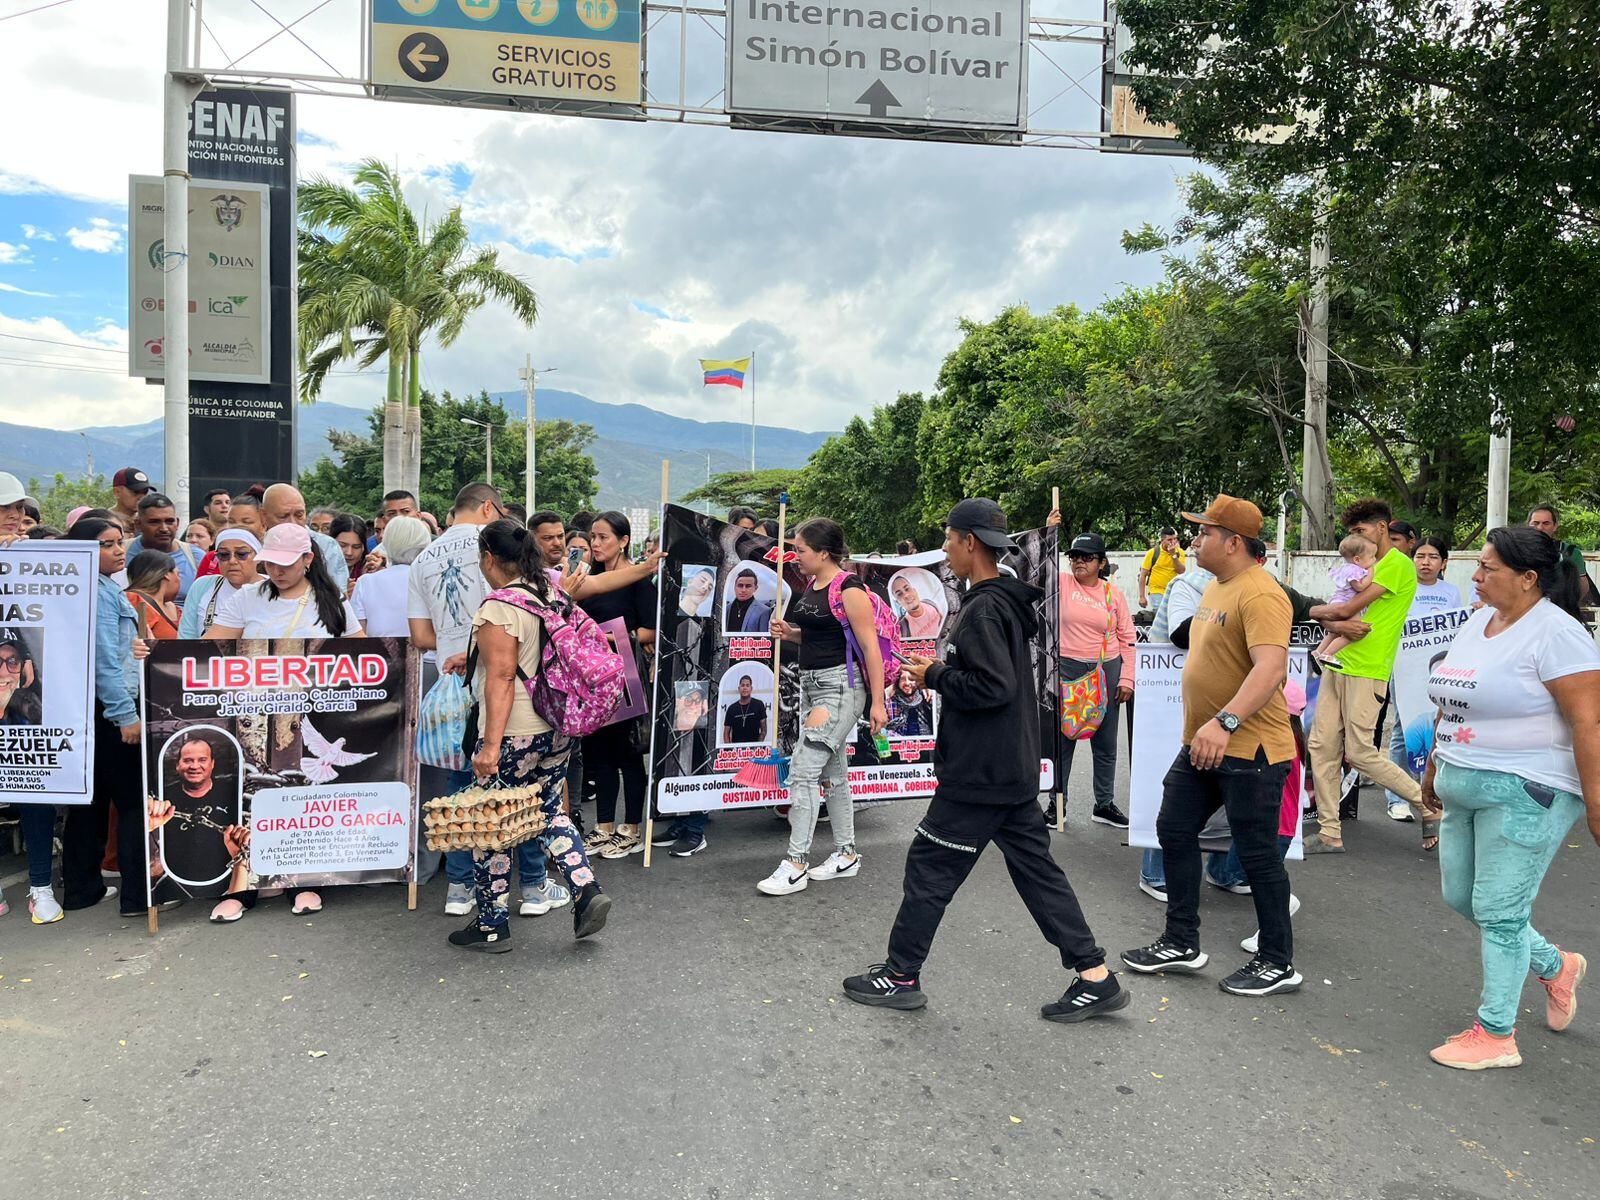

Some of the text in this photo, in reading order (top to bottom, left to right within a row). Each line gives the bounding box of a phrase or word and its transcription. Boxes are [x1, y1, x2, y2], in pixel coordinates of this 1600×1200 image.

[748, 0, 1002, 37] Internacional
[497, 44, 611, 69] SERVICIOS
[745, 36, 1009, 79] Simón Bolívar
[491, 67, 617, 92] GRATUITOS
[189, 139, 279, 155] NTRO NACIONAL DE
[187, 150, 285, 167] NCIÓN EN FRONTERAS
[219, 255, 254, 268] DIAN
[208, 297, 234, 314] ica
[188, 395, 284, 409] ÚBLICA DE COLOMBIA
[188, 407, 276, 419] ORTE DE SANTANDER
[417, 535, 479, 564] UNIVERS
[19, 562, 80, 576] PARA
[1400, 609, 1474, 638] IBERTA
[1289, 625, 1327, 645] ERA
[1402, 633, 1457, 650] PARA DAN
[749, 637, 772, 648] Danilo
[729, 648, 771, 660] Espitia Lara
[1140, 654, 1184, 669] RINC
[183, 655, 387, 690] LIBERTAD
[1429, 675, 1478, 690] mereces
[184, 689, 386, 705] Para el Ciudadano Colombiano
[1450, 699, 1470, 709] un
[217, 702, 261, 716] Javier
[264, 701, 311, 713] Giraldo
[9, 727, 75, 737] RETENIDO
[0, 738, 73, 752] EZUELA
[846, 745, 856, 755] ón
[0, 752, 58, 765] MENTE
[718, 747, 737, 759] José
[738, 747, 753, 758] Luis
[754, 746, 764, 757] de
[1040, 763, 1048, 773] TE
[1413, 755, 1425, 769] Tu
[847, 771, 866, 781] ENTE
[879, 769, 921, 780] Venezuela
[664, 782, 700, 796] Algunos
[904, 781, 938, 792] GOBIERN
[291, 792, 331, 801] Ciudadano
[333, 791, 378, 799] Colombiano
[722, 789, 788, 804] GUSTAVO PETRO
[302, 799, 358, 814] JAVIER
[256, 809, 407, 832] GIRALDO GARCÍA,
[267, 844, 316, 854] Actualmente
[309, 850, 333, 858] Rodeo
[276, 859, 301, 867] Donde
[304, 857, 345, 865] Permanece
